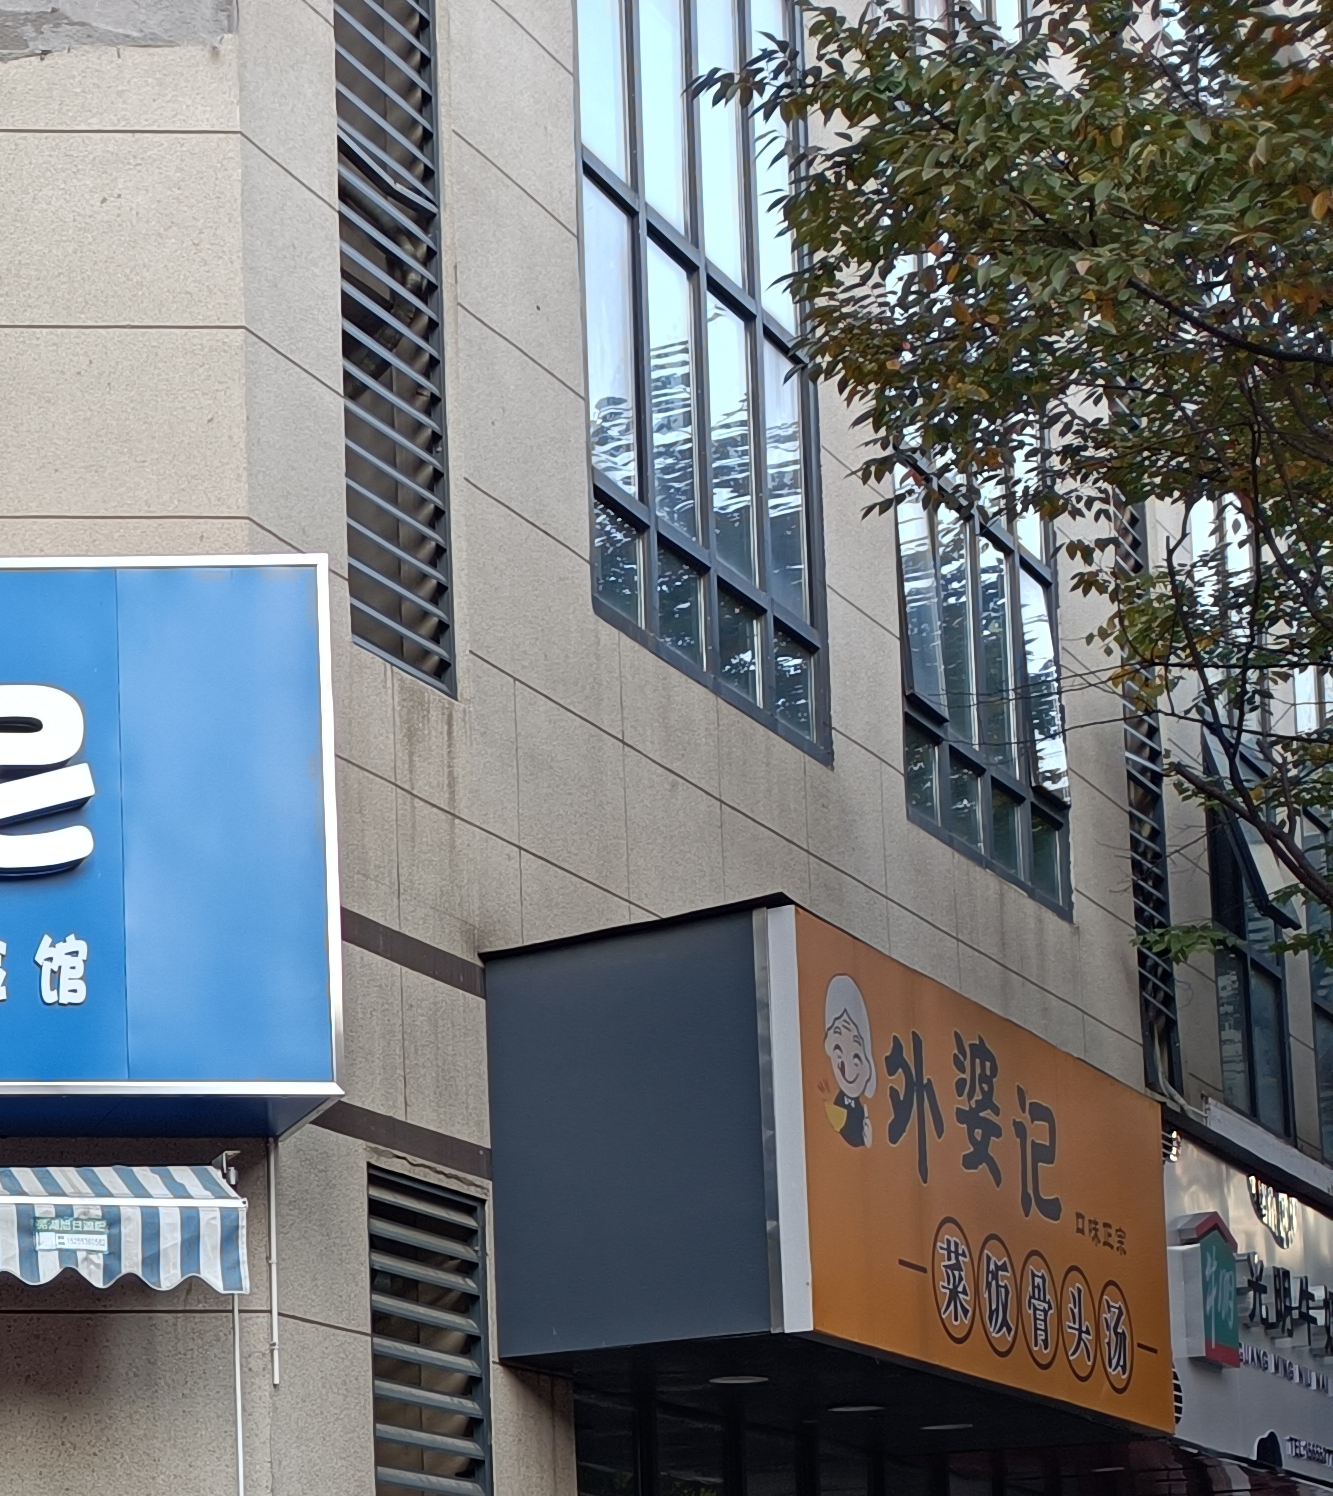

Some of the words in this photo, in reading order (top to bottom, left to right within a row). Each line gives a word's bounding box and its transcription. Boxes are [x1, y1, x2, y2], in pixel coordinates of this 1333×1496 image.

[884, 1029, 1062, 1224] 外婆记
[1074, 1210, 1129, 1256] 口味正宗
[938, 1236, 1130, 1379] 菜饭骨头汤
